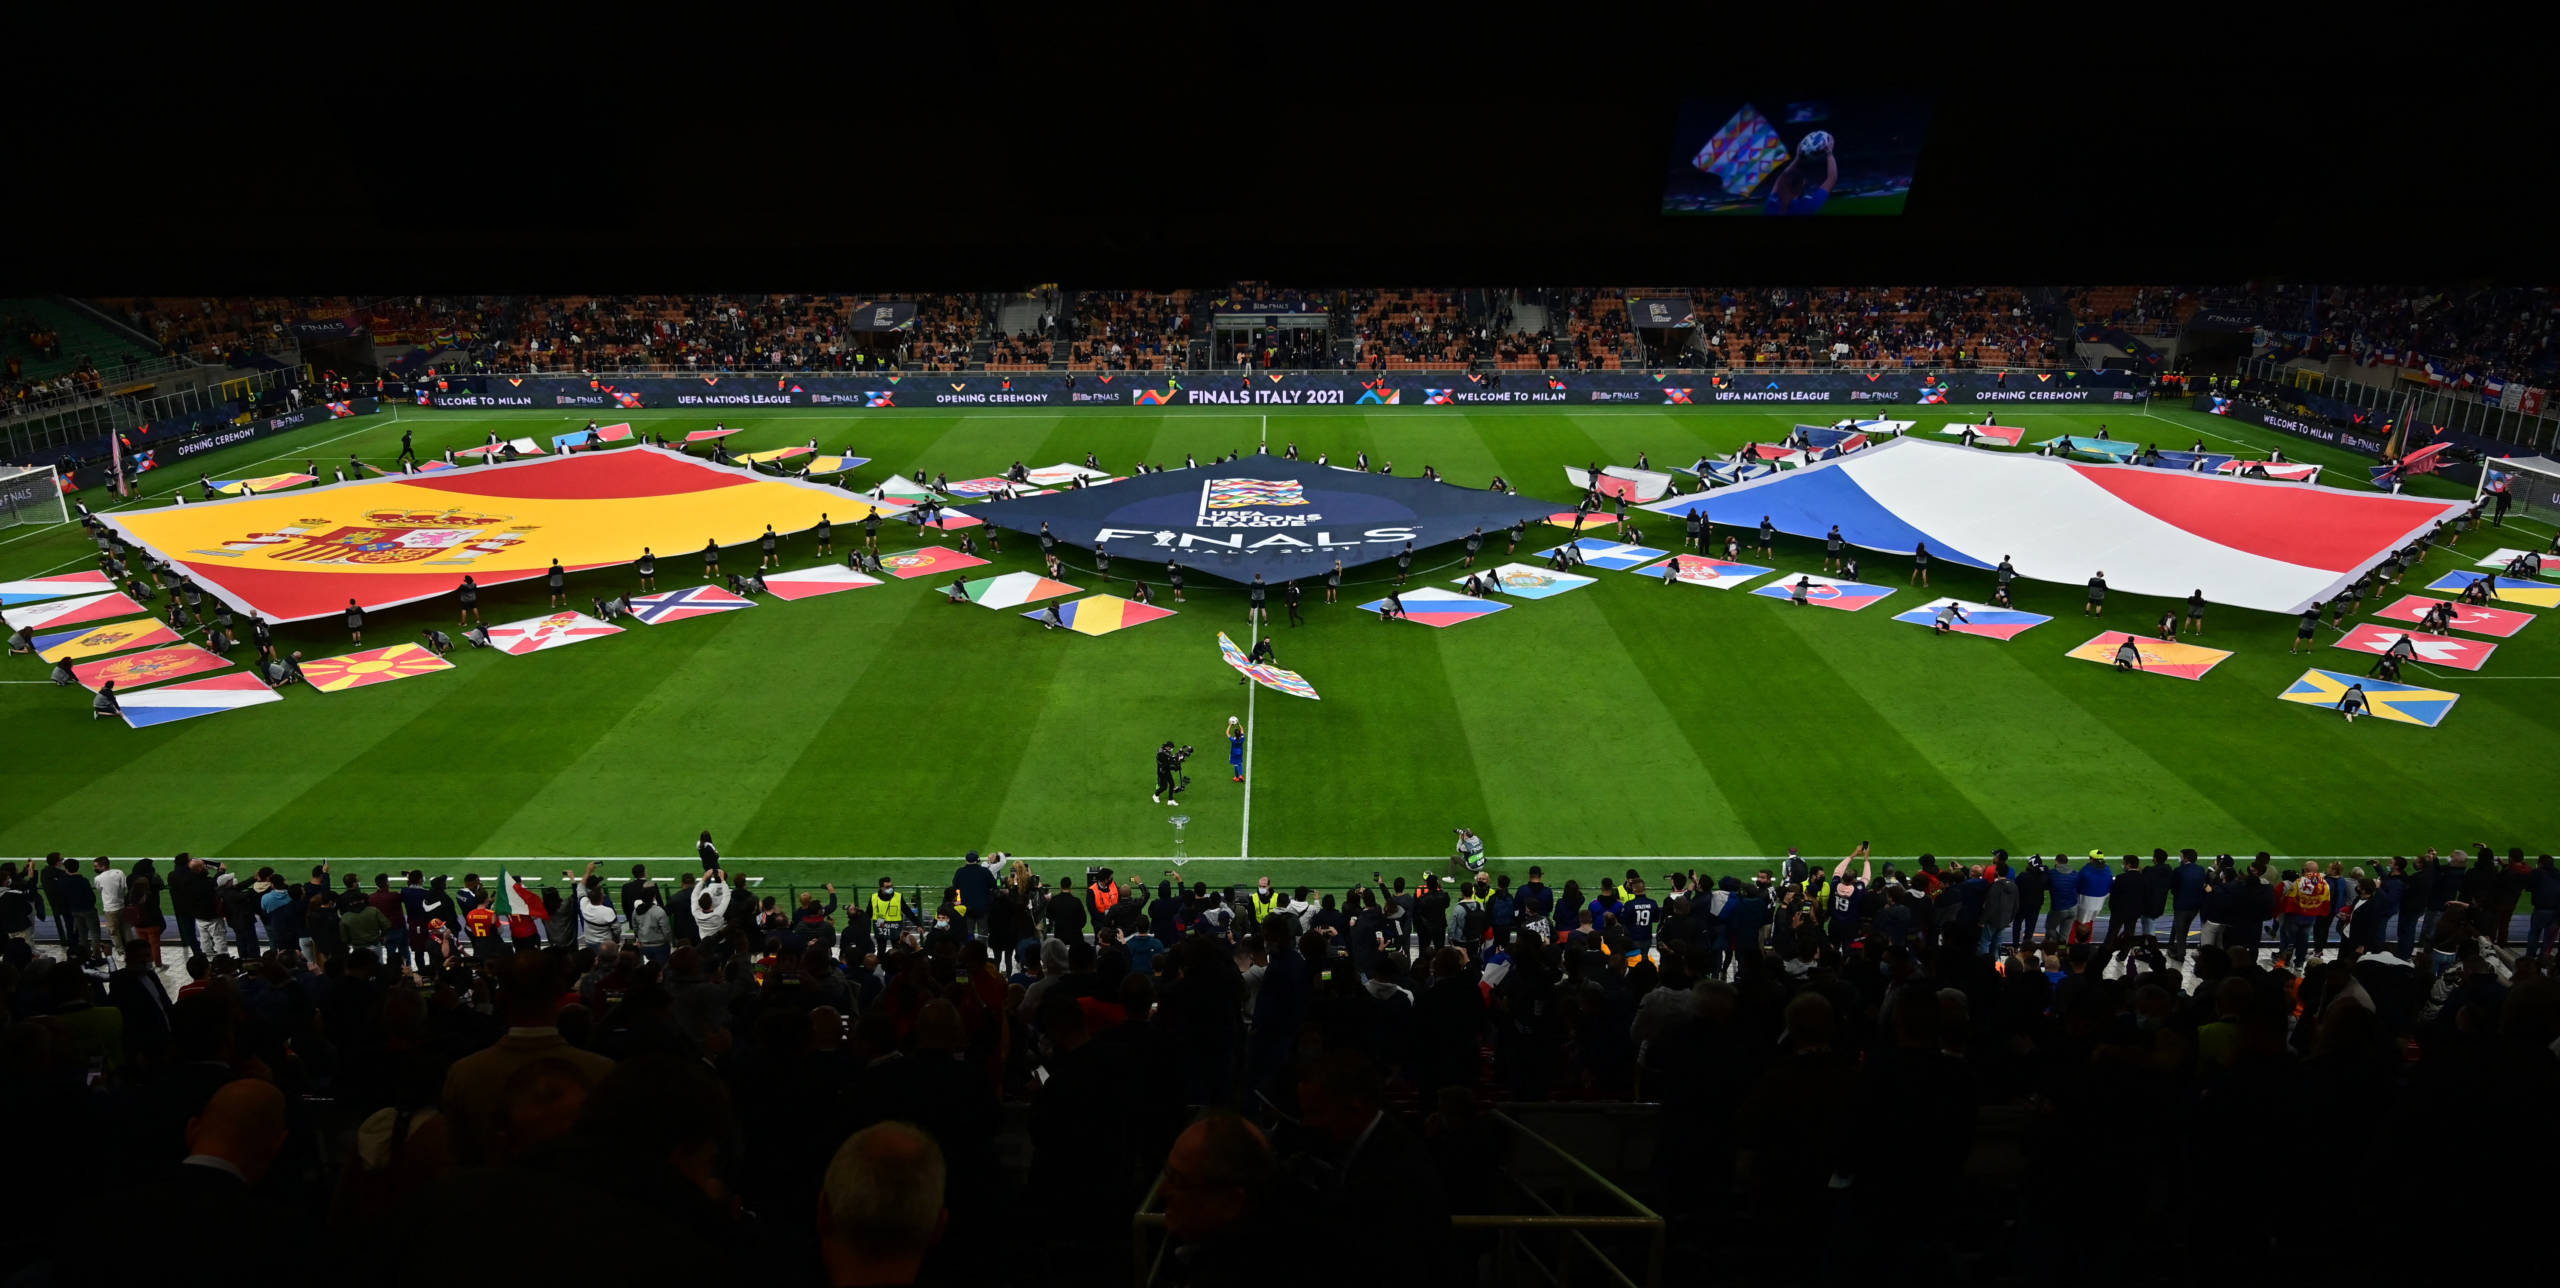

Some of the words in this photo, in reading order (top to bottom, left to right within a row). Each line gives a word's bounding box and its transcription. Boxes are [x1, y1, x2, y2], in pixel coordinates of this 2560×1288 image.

[2207, 314, 2252, 323] FINALS
[301, 322, 345, 331] FINALS
[577, 396, 603, 404] FINALS
[678, 395, 703, 404] UEFA
[706, 395, 750, 404] NATIONS
[752, 394, 791, 404] LEAGUE
[832, 394, 859, 402] FINALS
[936, 393, 986, 403] OPENING
[989, 393, 1048, 402] CEREMONY
[1093, 392, 1120, 401] FINALS
[1189, 390, 1250, 404] FINALS
[1255, 390, 1301, 404] ITALY
[1306, 390, 1344, 404] 2021
[1457, 391, 1511, 401] WELCOME
[1514, 391, 1529, 401] TO
[1532, 391, 1566, 401] MILAN
[1612, 391, 1640, 400] FINALS
[1715, 391, 1741, 400] UEFA
[1744, 391, 1788, 400] NATIONS
[1790, 391, 1830, 400] LEAGUE
[1871, 391, 1898, 399] FINALS
[1976, 391, 2026, 400] OPENING
[2029, 391, 2088, 400] CEREMONY
[480, 396, 495, 406] TO
[499, 396, 532, 405] MILAN
[285, 413, 305, 425] FINALS
[2263, 414, 2297, 431] WELCOME
[2299, 423, 2309, 434] TO
[2310, 428, 2334, 441] MILAN
[178, 437, 214, 456] OPENING
[215, 427, 255, 445] CEREMONY
[2357, 438, 2381, 453] FINALS
[3, 488, 32, 503] FNALS
[1199, 514, 1322, 522] NATIONS
[1211, 510, 1265, 518] UEFA
[1835, 895, 1849, 911] 19
[1635, 910, 1650, 926] 19
[474, 922, 487, 937] 6
